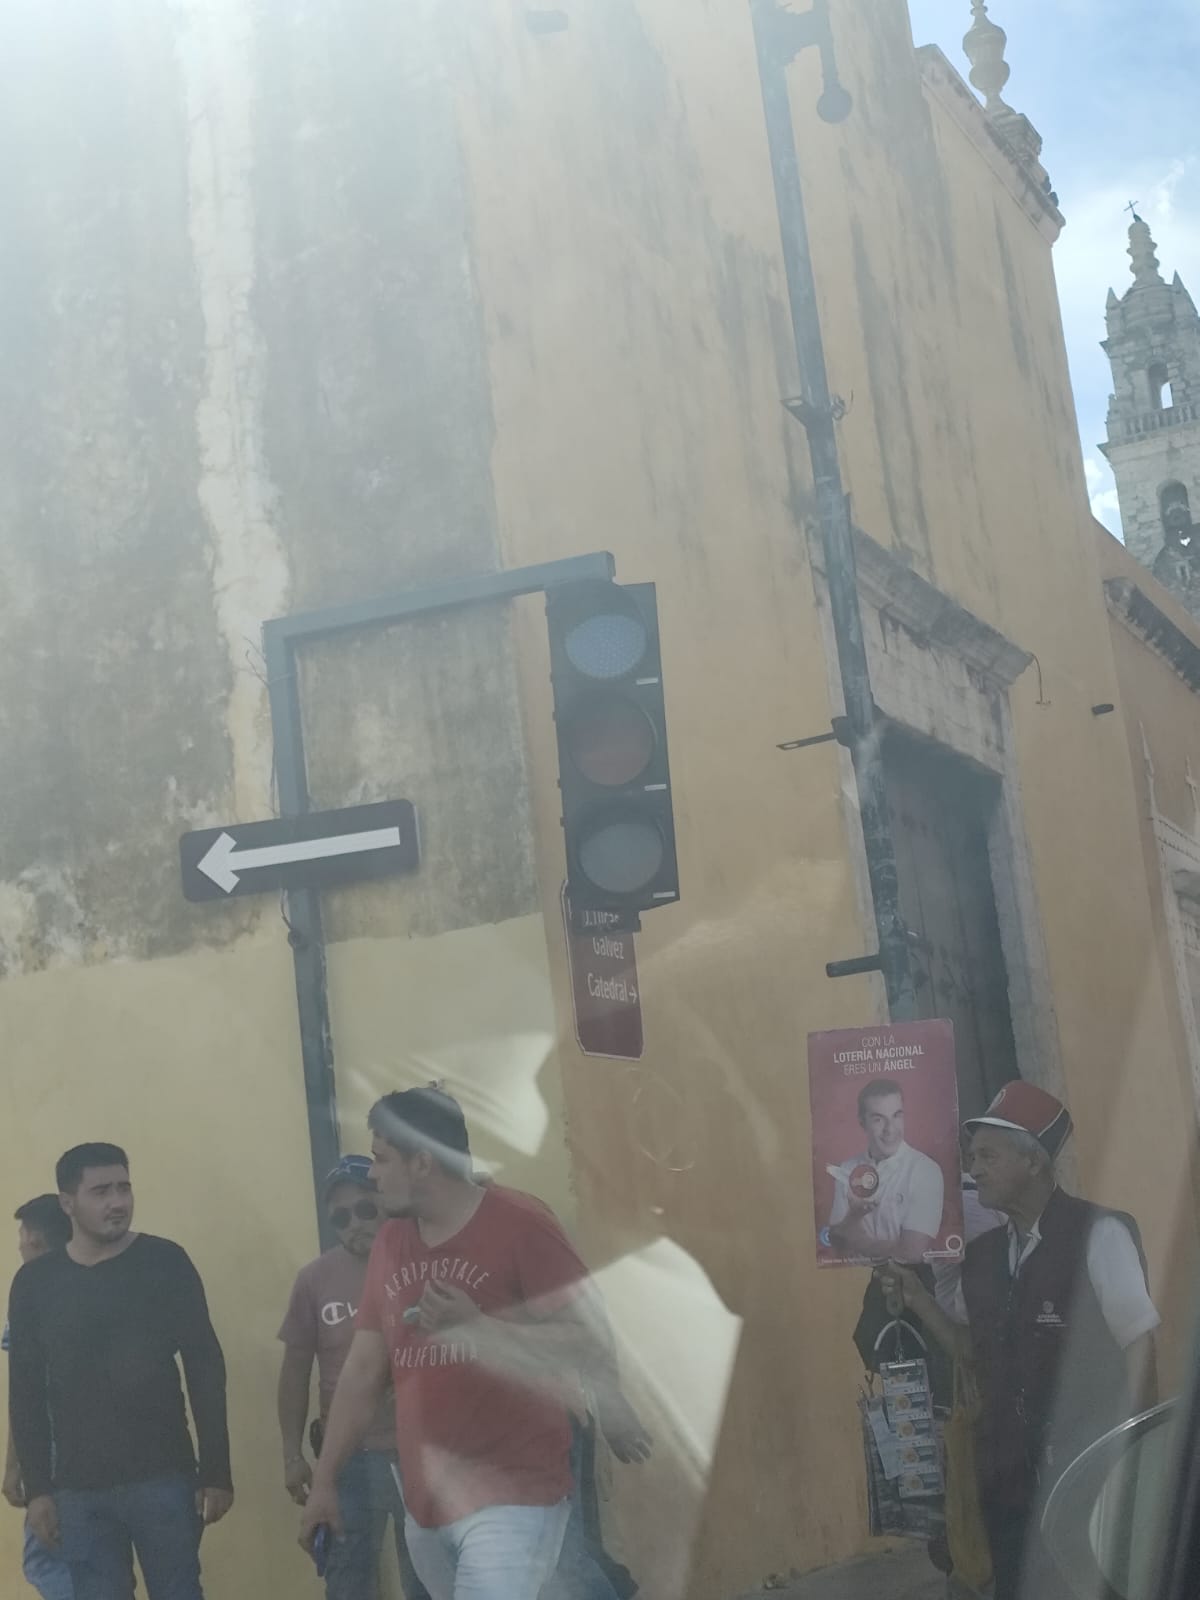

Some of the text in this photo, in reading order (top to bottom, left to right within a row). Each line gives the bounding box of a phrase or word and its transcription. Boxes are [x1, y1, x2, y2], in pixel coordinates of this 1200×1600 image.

[587, 972, 629, 1002] Catedral
[861, 1034, 896, 1048] CON LA
[875, 1045, 926, 1061] NACIONAL
[843, 1063, 867, 1076] ERES
[868, 1062, 882, 1073] UN
